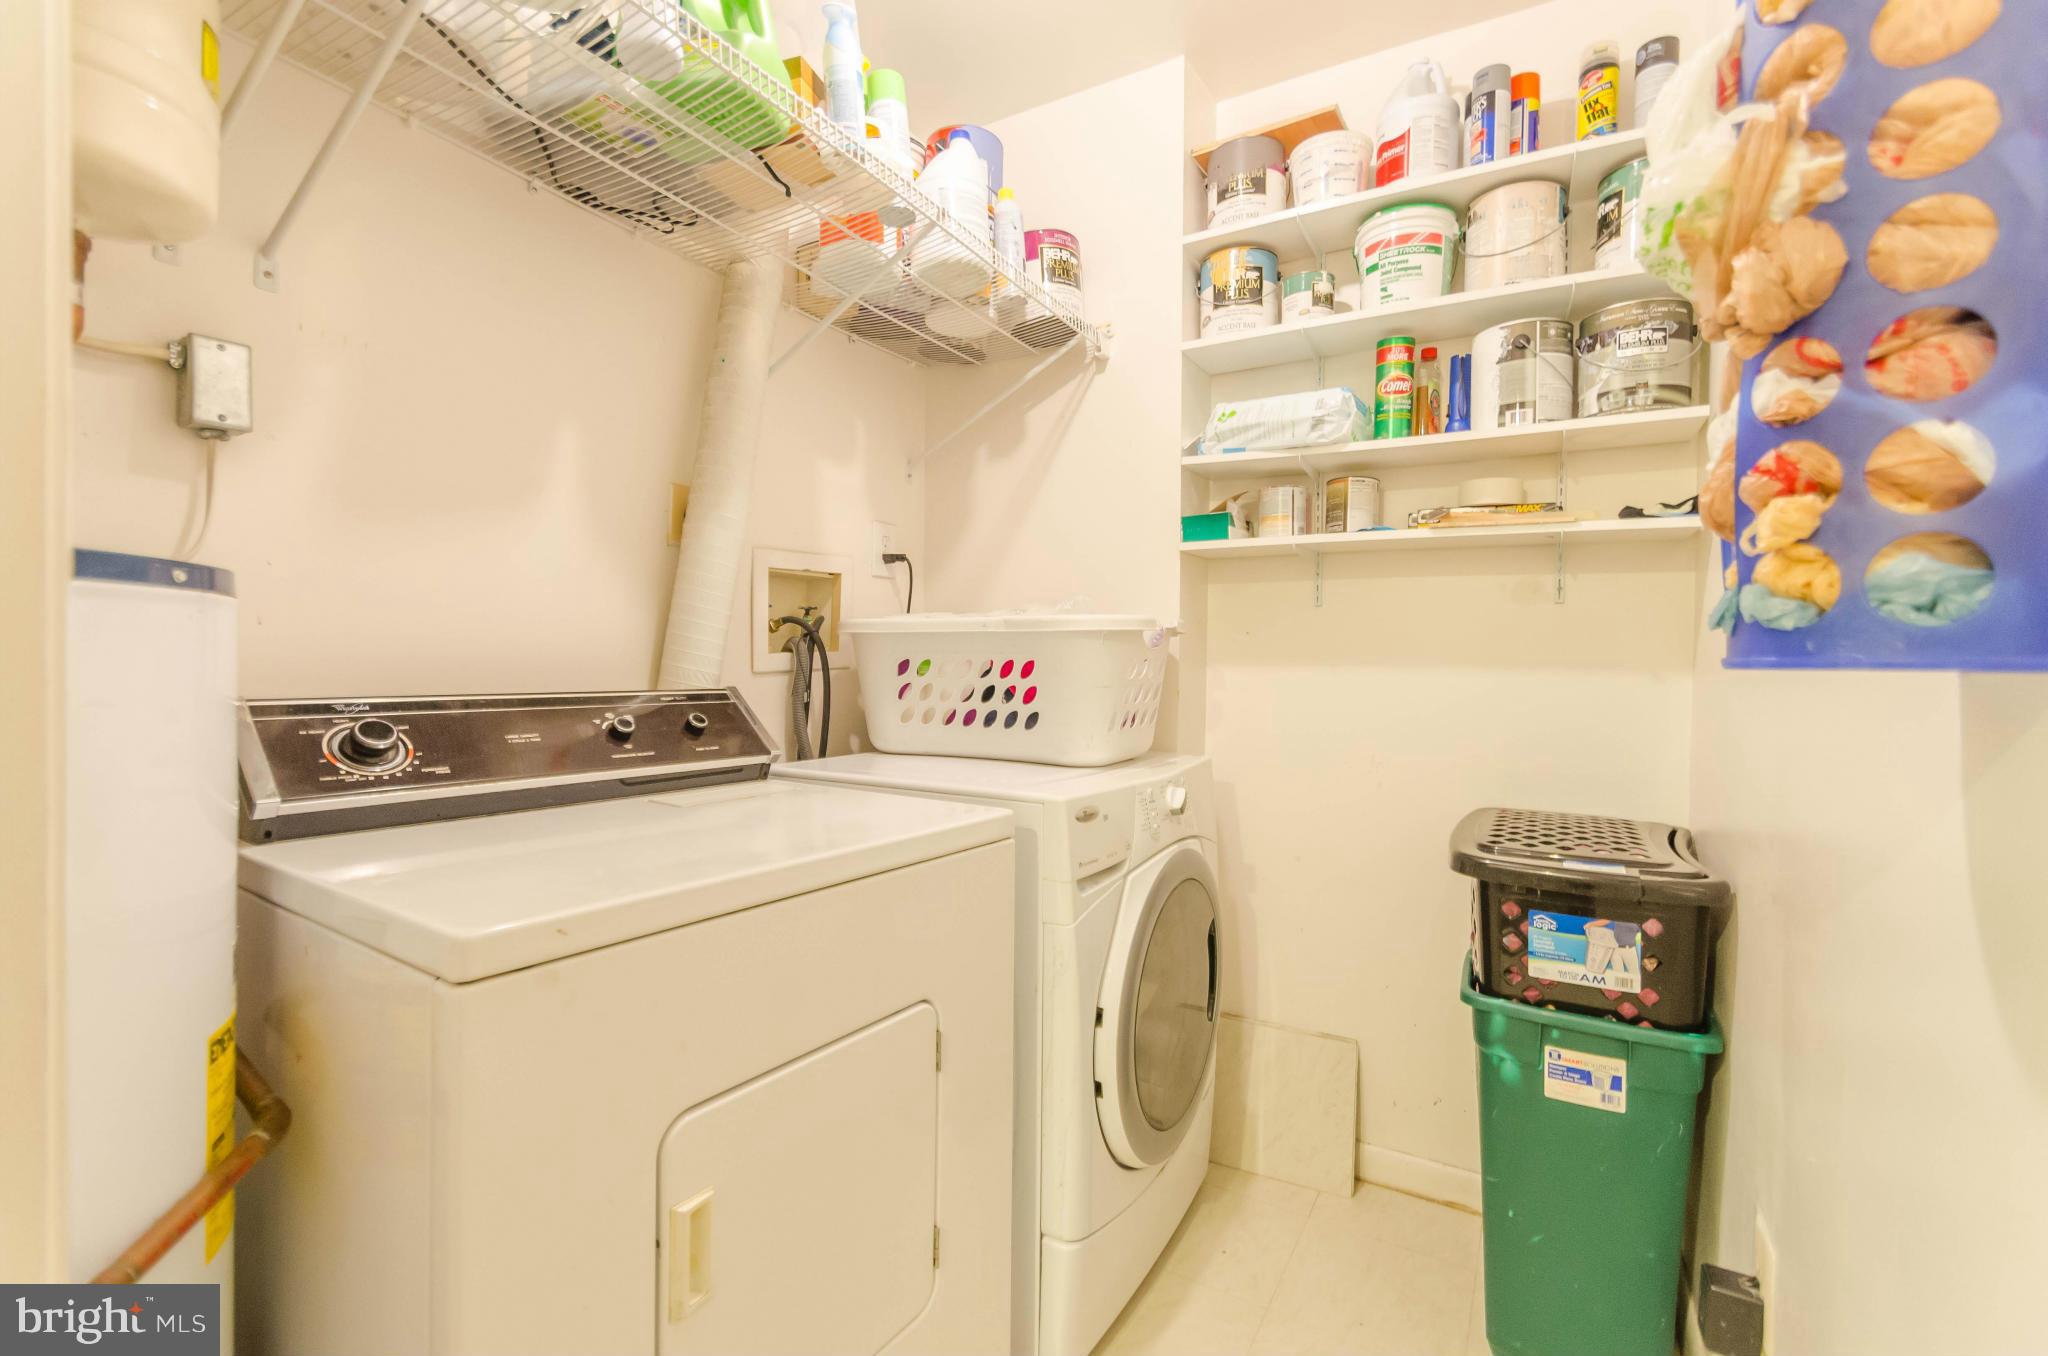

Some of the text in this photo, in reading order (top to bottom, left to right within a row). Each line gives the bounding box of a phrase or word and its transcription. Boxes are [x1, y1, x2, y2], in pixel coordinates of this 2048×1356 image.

[1055, 268, 1075, 281] PLUS
[1215, 278, 1260, 293] PREMIUM
[1225, 288, 1250, 301] PLUS
[1620, 329, 1654, 343] BEHR
[1380, 378, 1411, 394] Comet
[1515, 503, 1542, 513] MAX
[1533, 919, 1557, 932] logic
